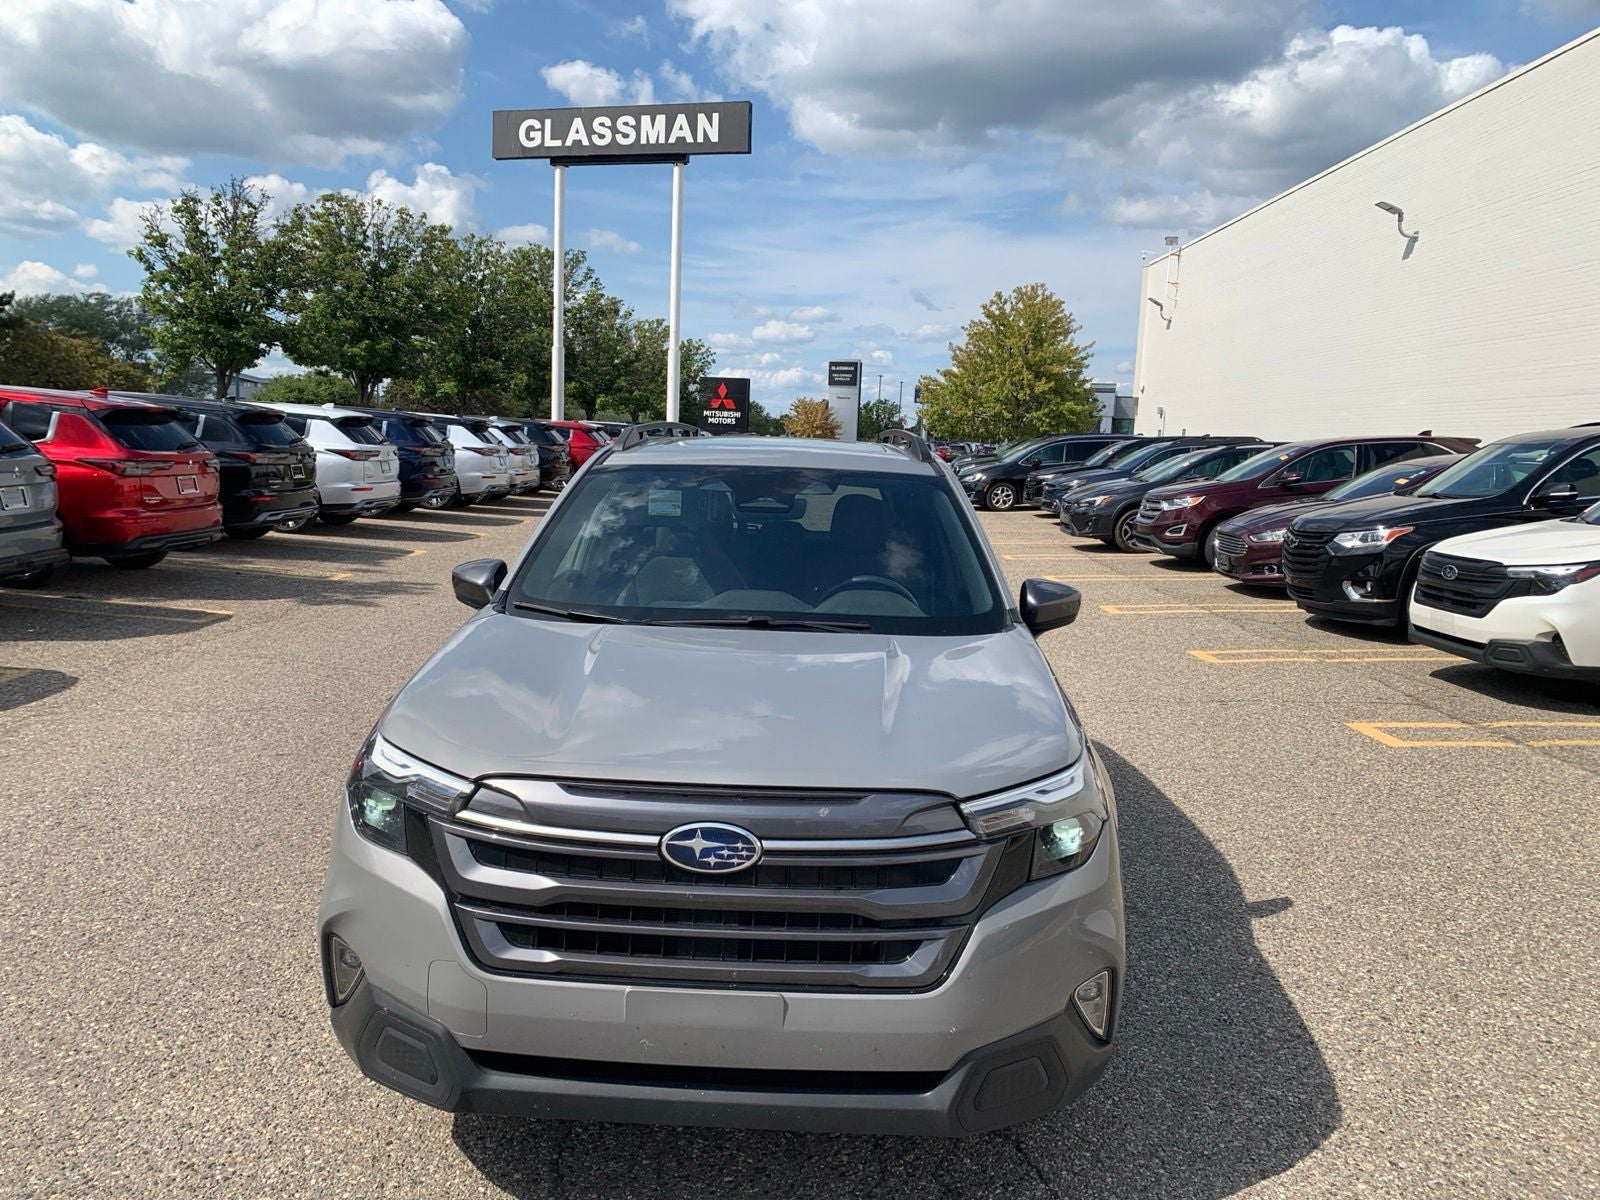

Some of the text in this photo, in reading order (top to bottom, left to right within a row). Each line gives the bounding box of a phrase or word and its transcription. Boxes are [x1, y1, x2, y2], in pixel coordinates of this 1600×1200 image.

[518, 112, 720, 148] GLASSMAN
[703, 410, 741, 418] MITSUBISHI
[708, 417, 736, 425] MOTORS
